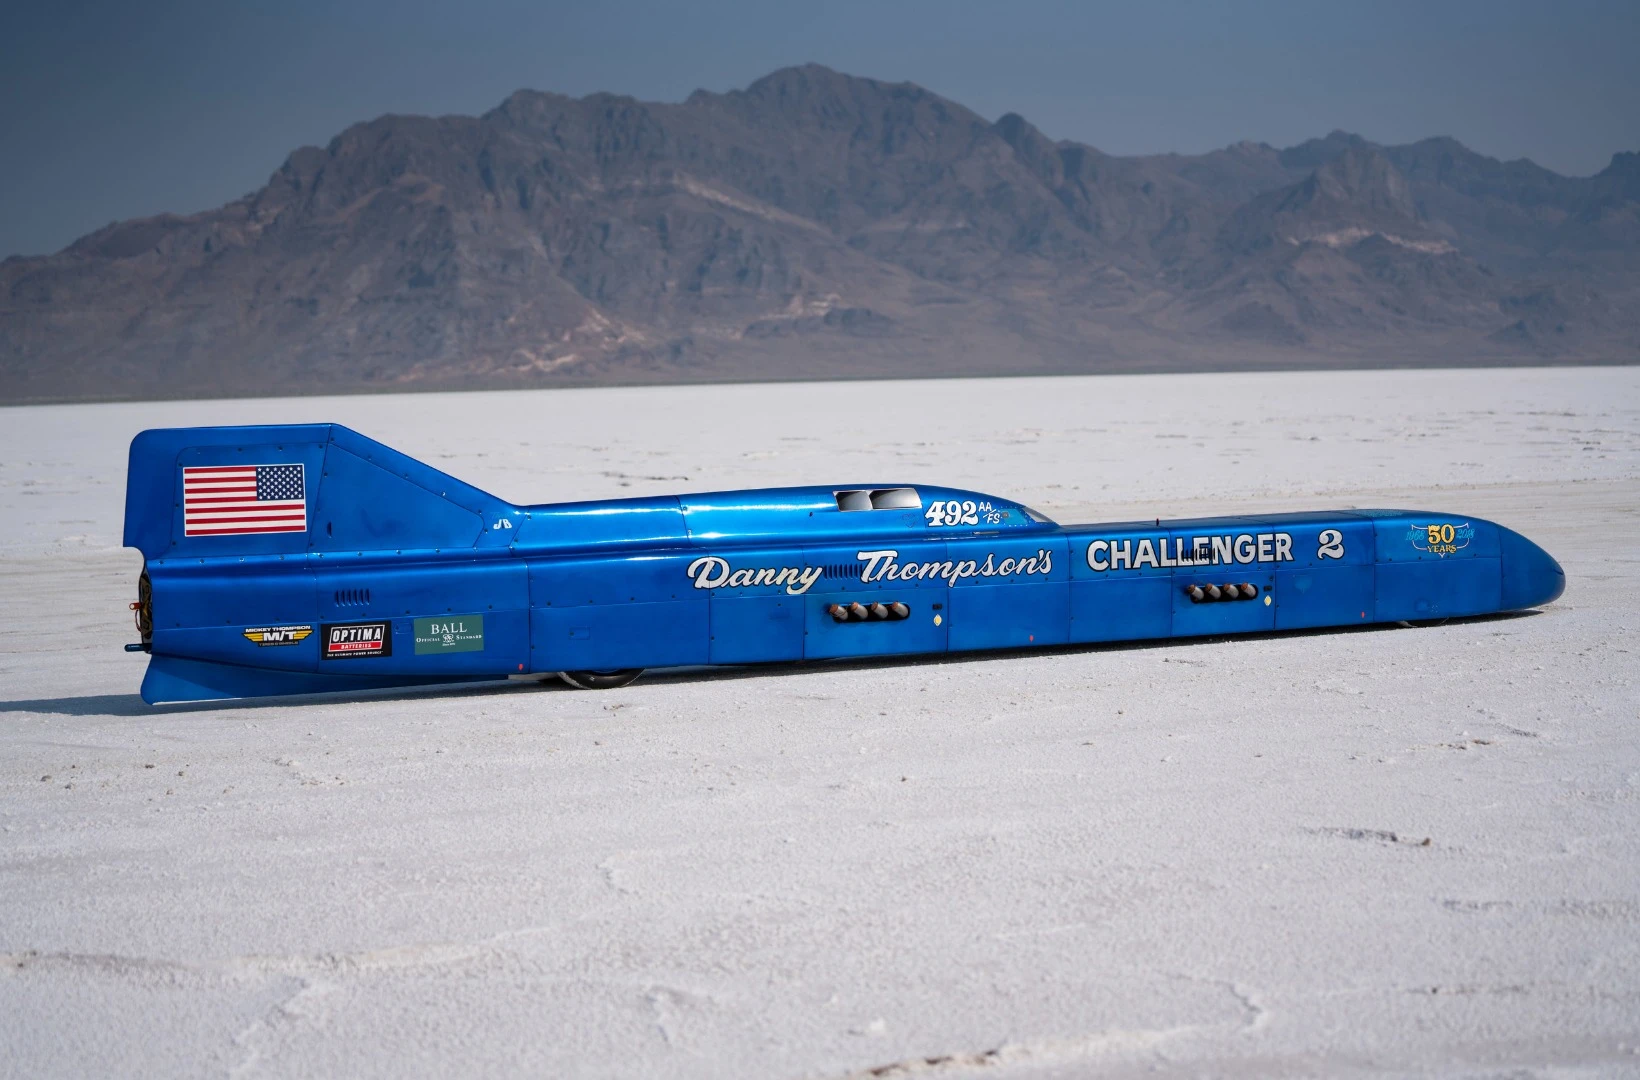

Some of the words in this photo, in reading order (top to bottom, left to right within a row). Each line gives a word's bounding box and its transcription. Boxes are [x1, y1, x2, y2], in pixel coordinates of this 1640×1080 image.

[925, 500, 979, 527] 492
[978, 502, 992, 512] AA
[1427, 523, 1456, 544] 50
[1086, 532, 1294, 572] CHALLENGER
[1317, 529, 1345, 560] 2
[1427, 544, 1457, 554] YEARS
[686, 555, 824, 595] Danny
[856, 548, 1053, 588] Thompson's
[263, 630, 298, 642] M/T
[332, 627, 381, 643] OPTIMA
[431, 622, 468, 635] BALL
